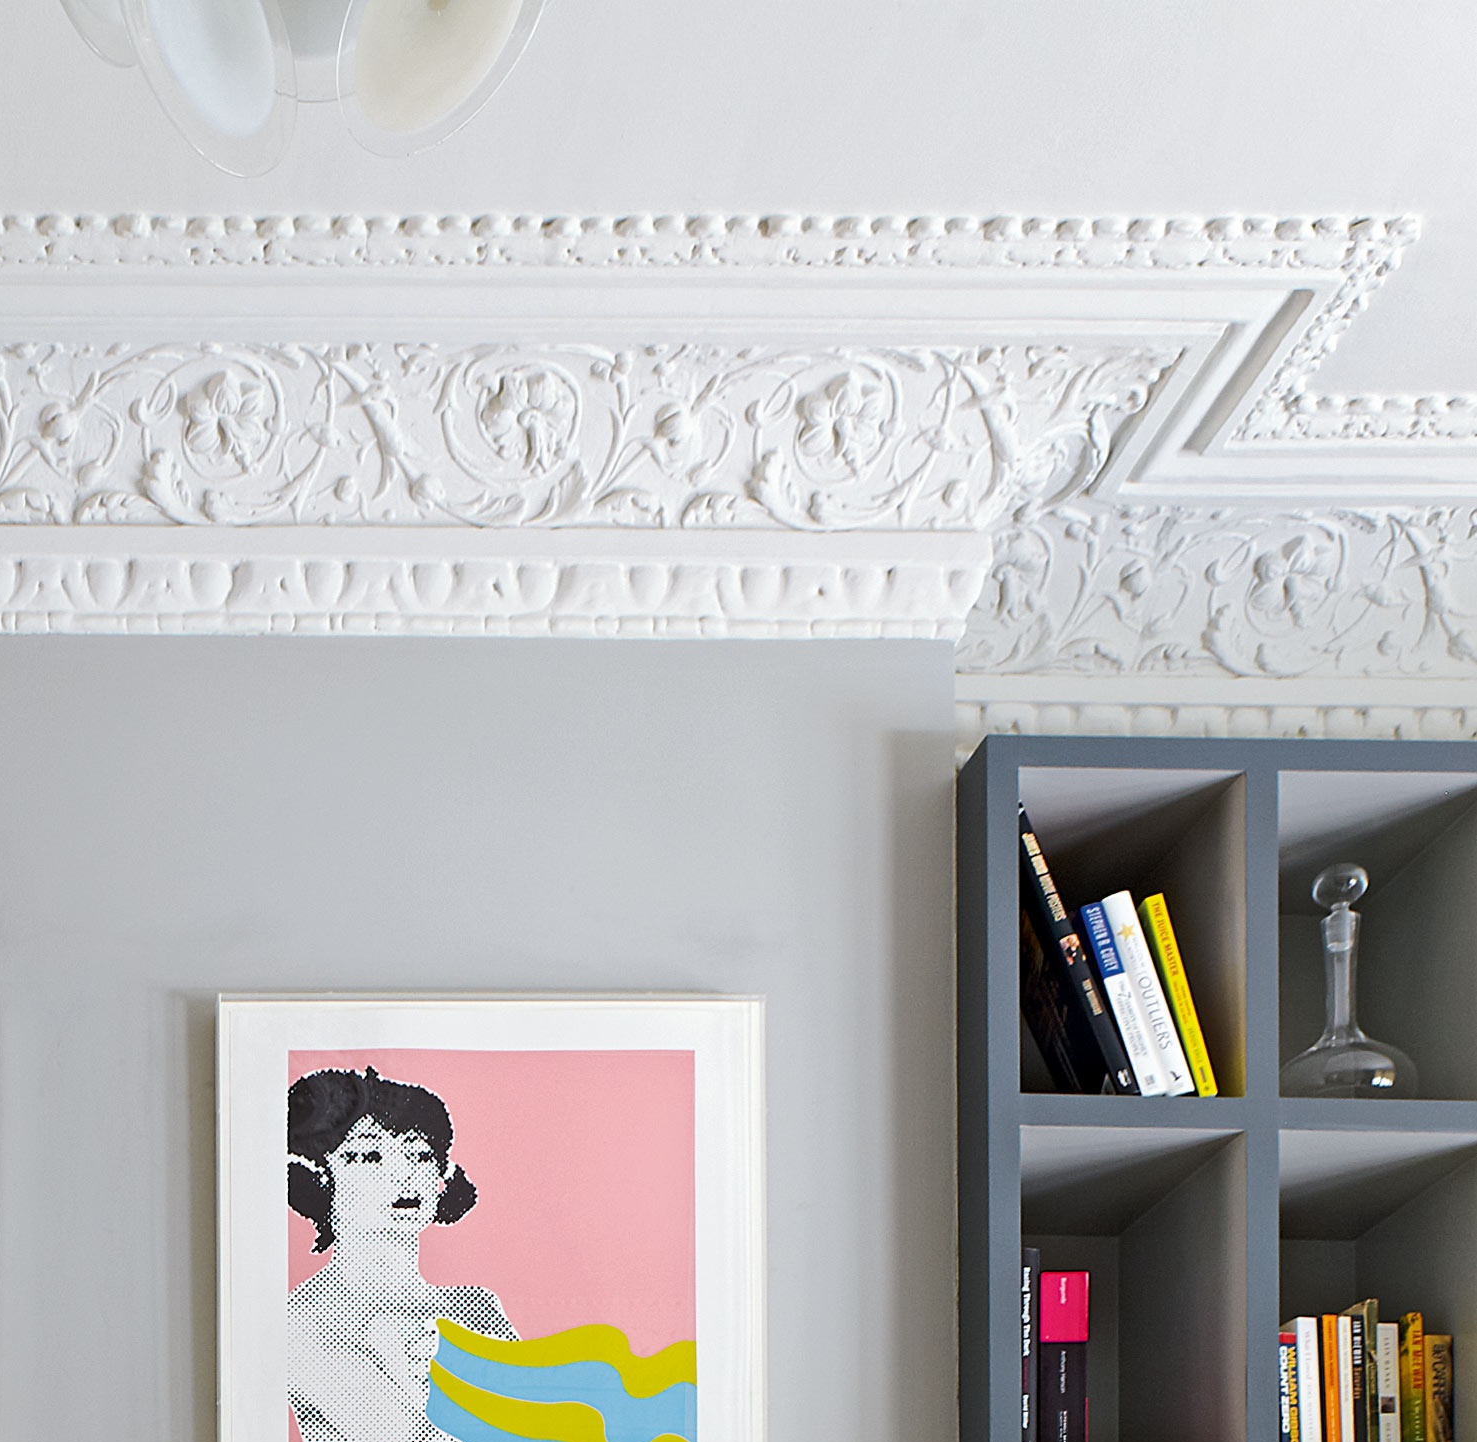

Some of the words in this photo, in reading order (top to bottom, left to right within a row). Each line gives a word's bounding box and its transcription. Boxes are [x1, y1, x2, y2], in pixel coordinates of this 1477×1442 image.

[1138, 976, 1172, 1050] OUTLIERS
[1279, 1346, 1290, 1395] COUNT
[1286, 1346, 1297, 1404] WILLIAM
[1280, 1396, 1290, 1433] ZERO
